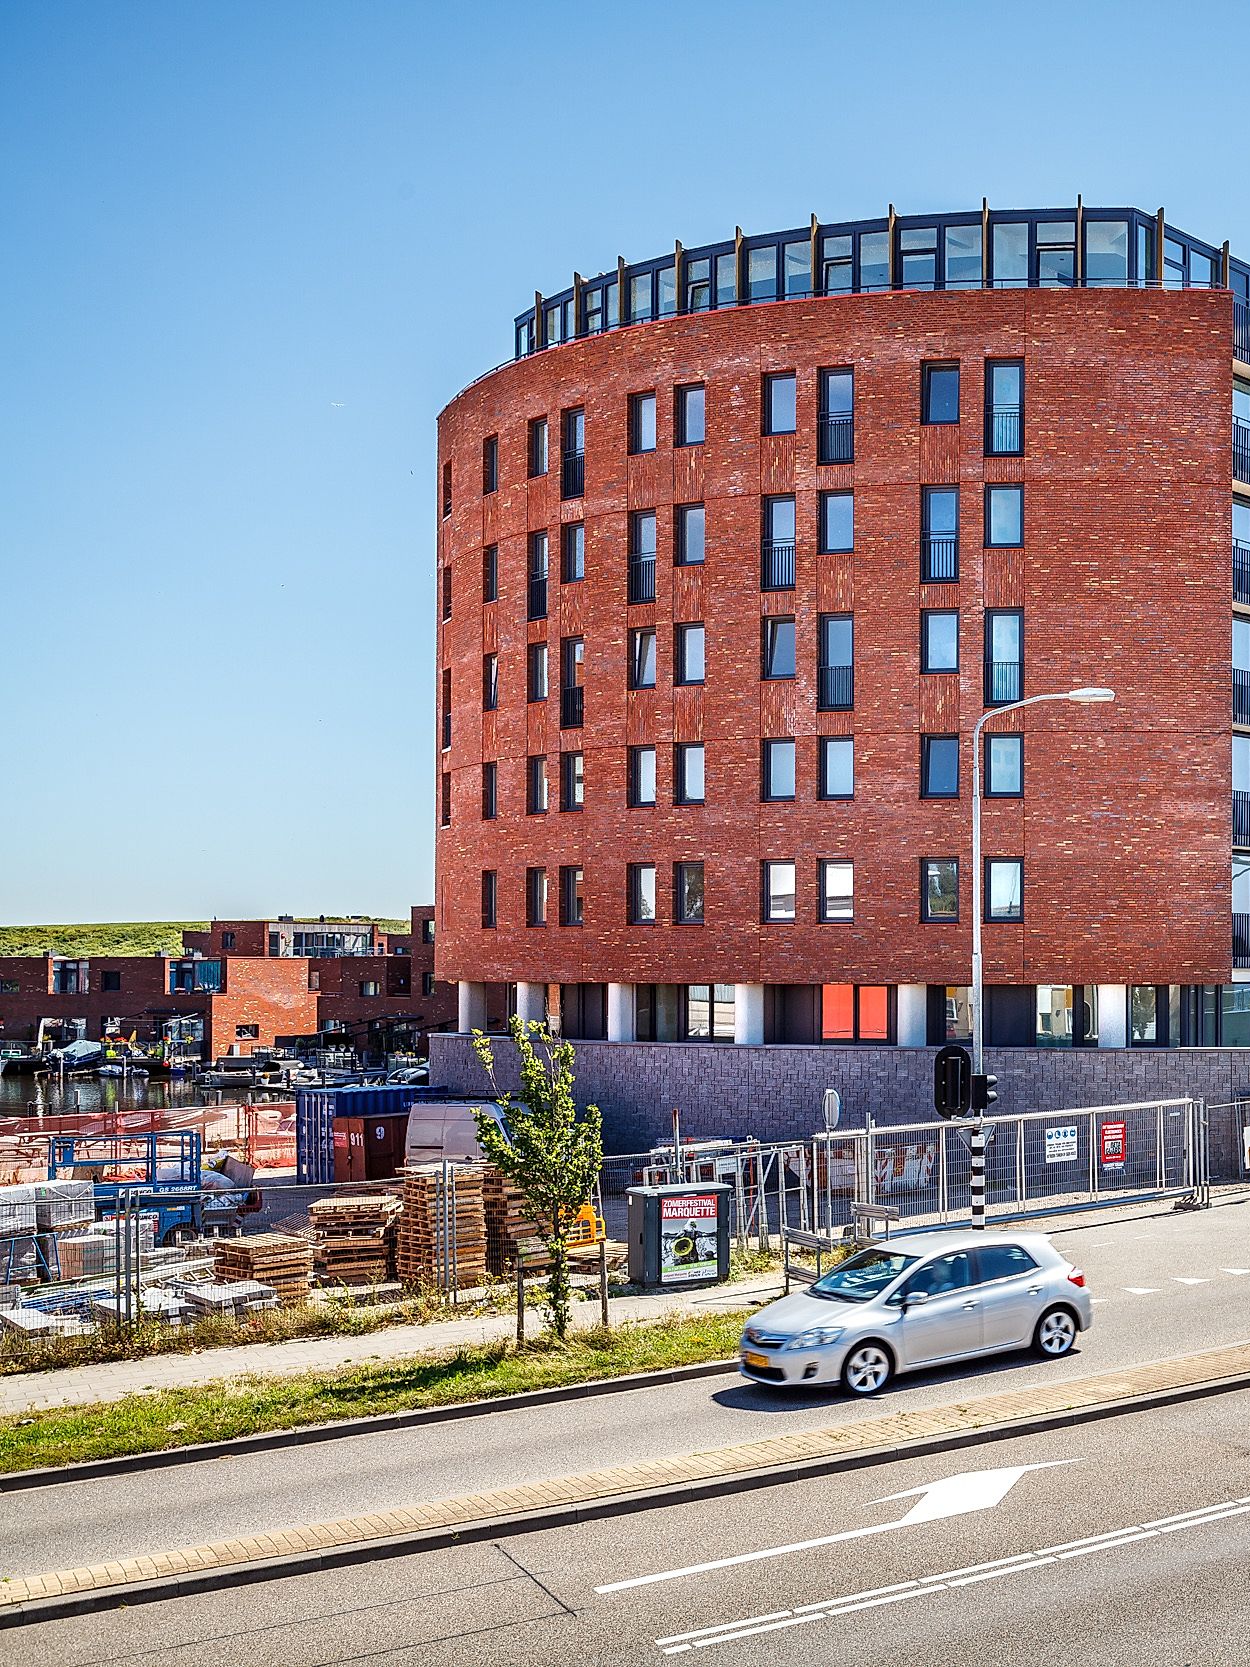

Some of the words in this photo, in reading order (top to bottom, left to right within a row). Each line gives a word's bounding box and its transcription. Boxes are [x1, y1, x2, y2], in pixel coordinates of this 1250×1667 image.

[375, 1126, 385, 1139] 9
[350, 1133, 364, 1146] 911
[663, 1199, 715, 1207] ZOMERFESTIVAL
[663, 1206, 716, 1217] MARQUETTE
